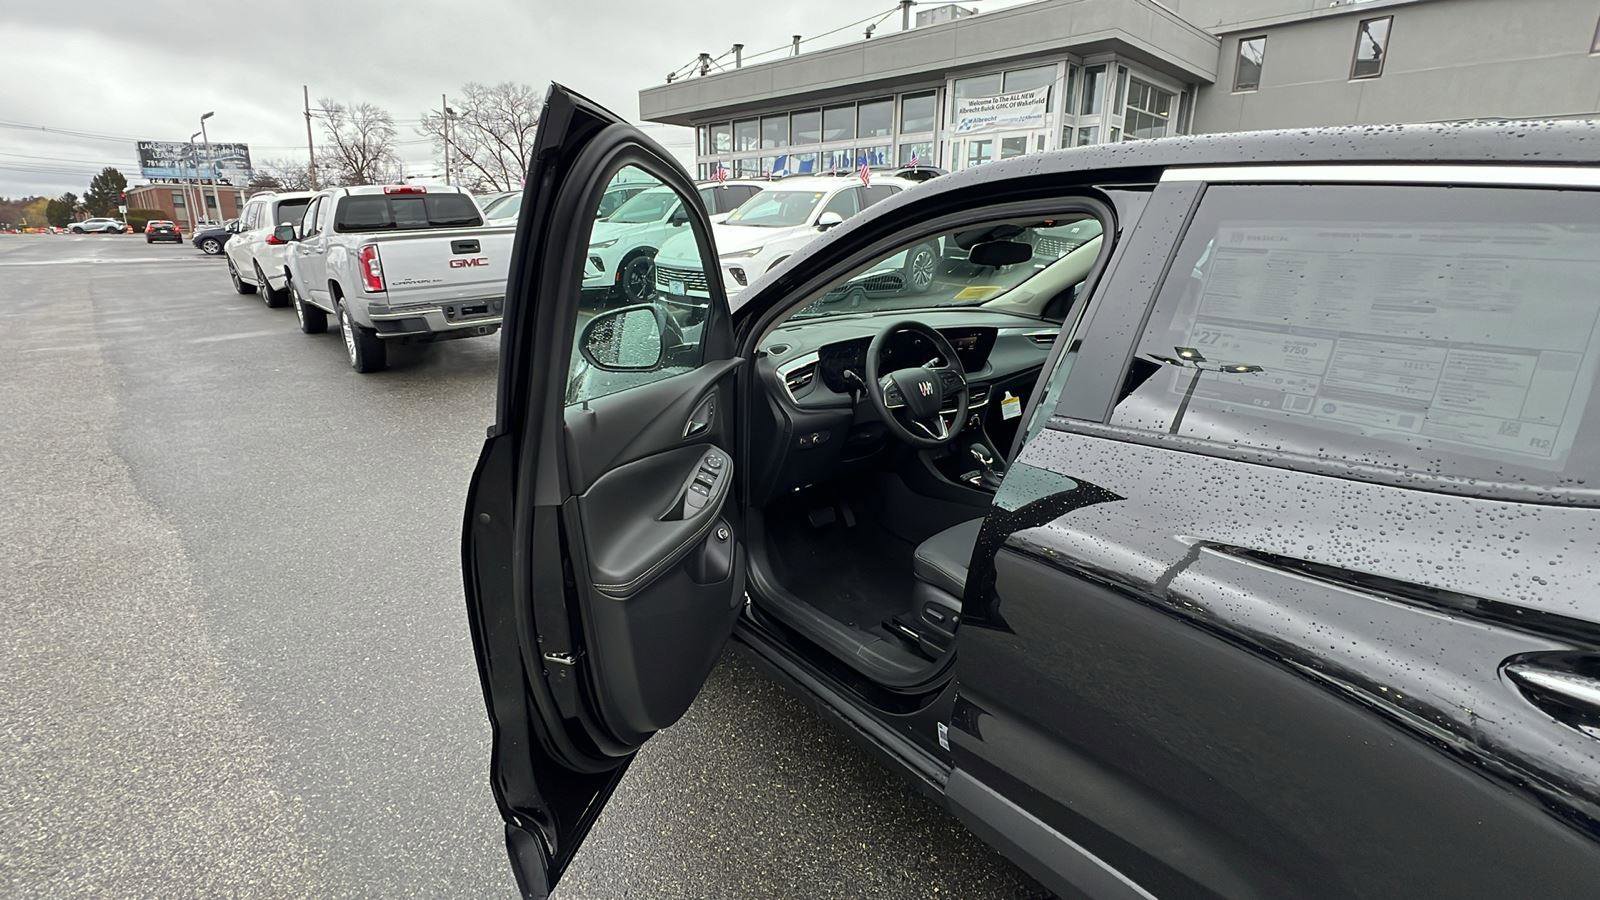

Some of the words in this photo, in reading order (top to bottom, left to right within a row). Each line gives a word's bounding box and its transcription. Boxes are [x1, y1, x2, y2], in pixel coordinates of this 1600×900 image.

[1021, 92, 1035, 100] NEW
[959, 106, 980, 114] Albrecht
[995, 102, 1009, 110] GMC
[1009, 101, 1017, 109] Of
[1016, 97, 1046, 107] Wakefield
[972, 115, 997, 123] Albrecht
[449, 257, 489, 269] GMC
[1199, 331, 1221, 344] 27
